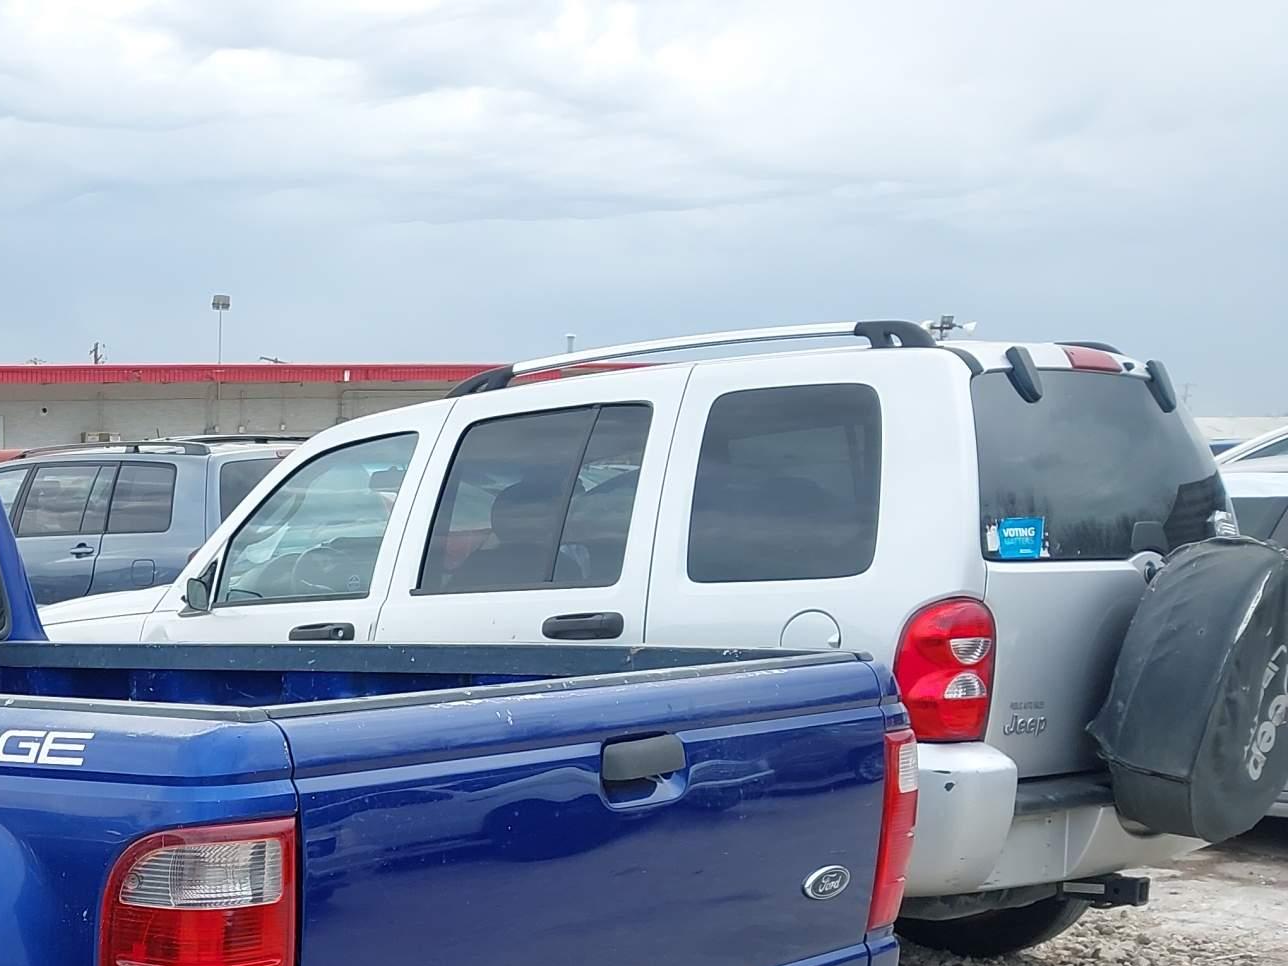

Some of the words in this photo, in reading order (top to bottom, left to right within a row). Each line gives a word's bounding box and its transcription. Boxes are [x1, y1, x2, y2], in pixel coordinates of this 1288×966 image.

[1002, 527, 1035, 537] VOTING
[1002, 712, 1048, 737] Jeep
[817, 872, 843, 893] Ford
